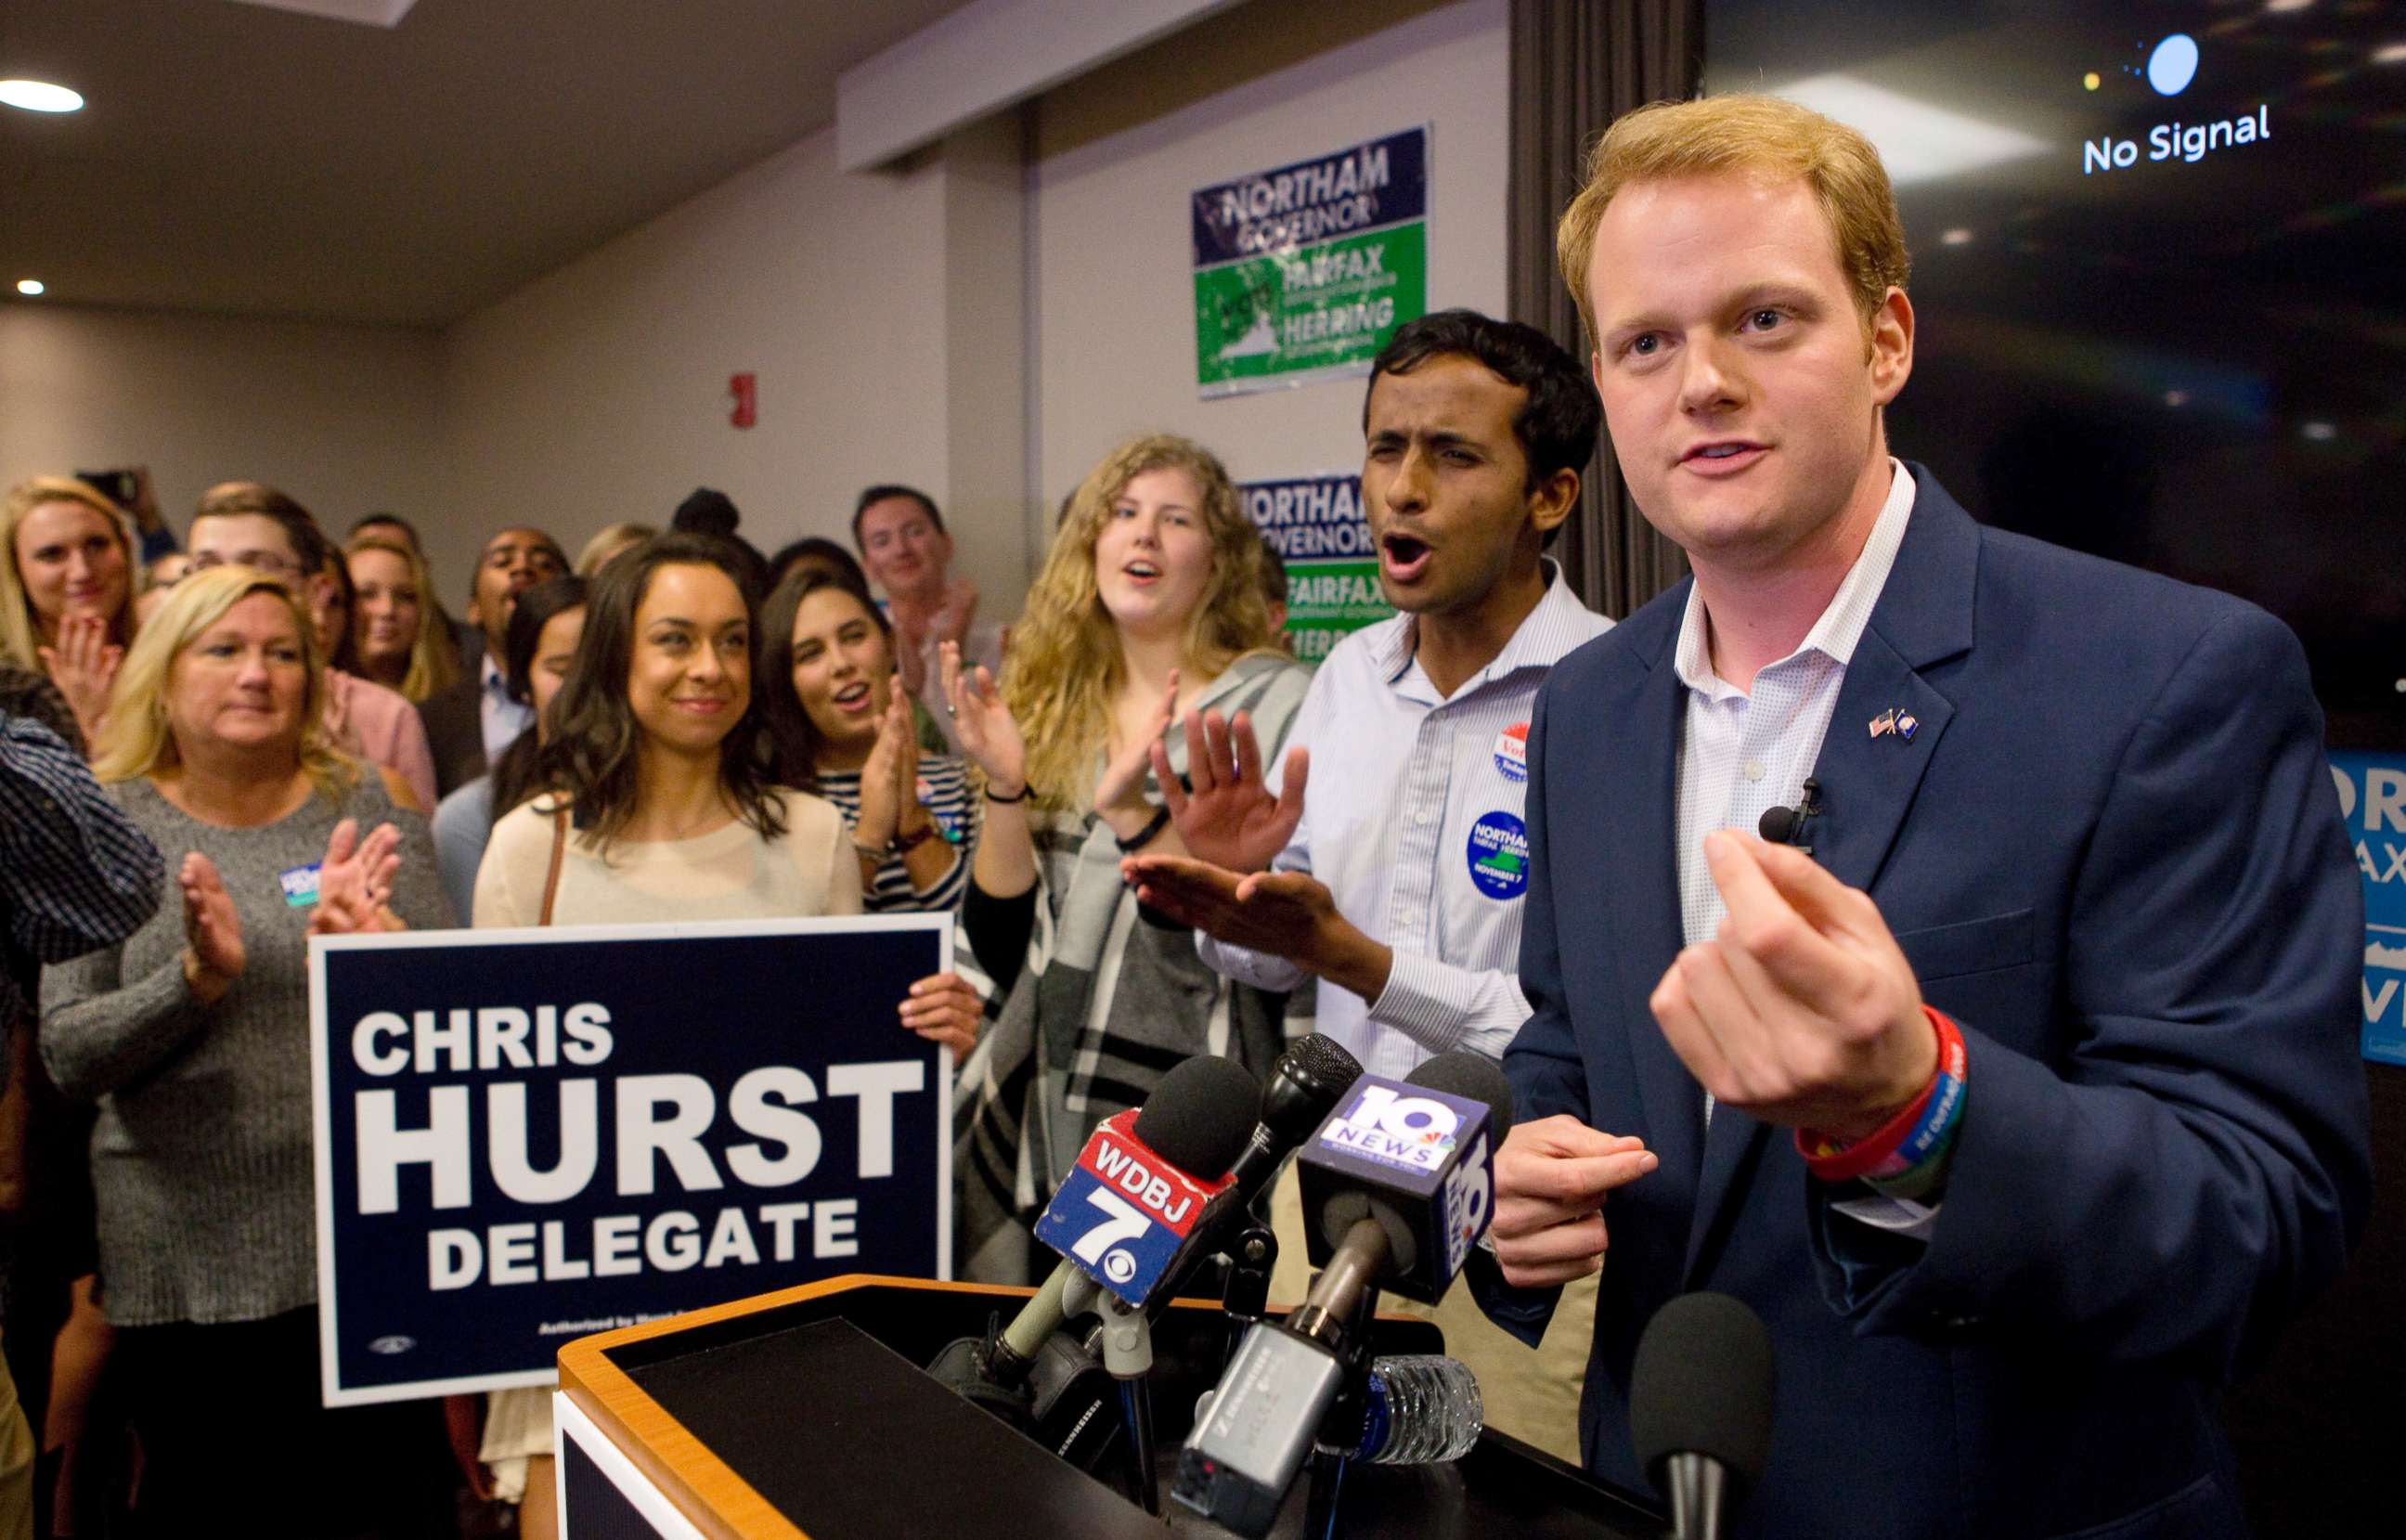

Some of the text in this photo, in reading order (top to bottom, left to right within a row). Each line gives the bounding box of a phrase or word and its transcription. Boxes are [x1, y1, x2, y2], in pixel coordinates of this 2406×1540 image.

[2084, 104, 2270, 175] No Signal
[1222, 146, 1390, 226] NORTHAM
[1237, 194, 1372, 252] GOVERNOR
[1284, 243, 1384, 293] FAIRFAX
[1285, 296, 1394, 343] HERRING
[1261, 521, 1375, 555] OVERNOR
[1474, 862, 1523, 884] NOVEMBER 7
[2361, 977, 2406, 1029] V
[352, 1003, 614, 1077] CHRIS
[355, 1060, 925, 1214] HURST
[1349, 1084, 1458, 1144] 10
[1337, 1126, 1432, 1163] NEWS
[1094, 1138, 1193, 1223] WDBJ
[428, 1199, 859, 1290] DELEGATE
[1071, 1185, 1153, 1267] 7
[1448, 1180, 1462, 1263] NEWS
[1057, 1399, 1103, 1456] SENNHEISER
